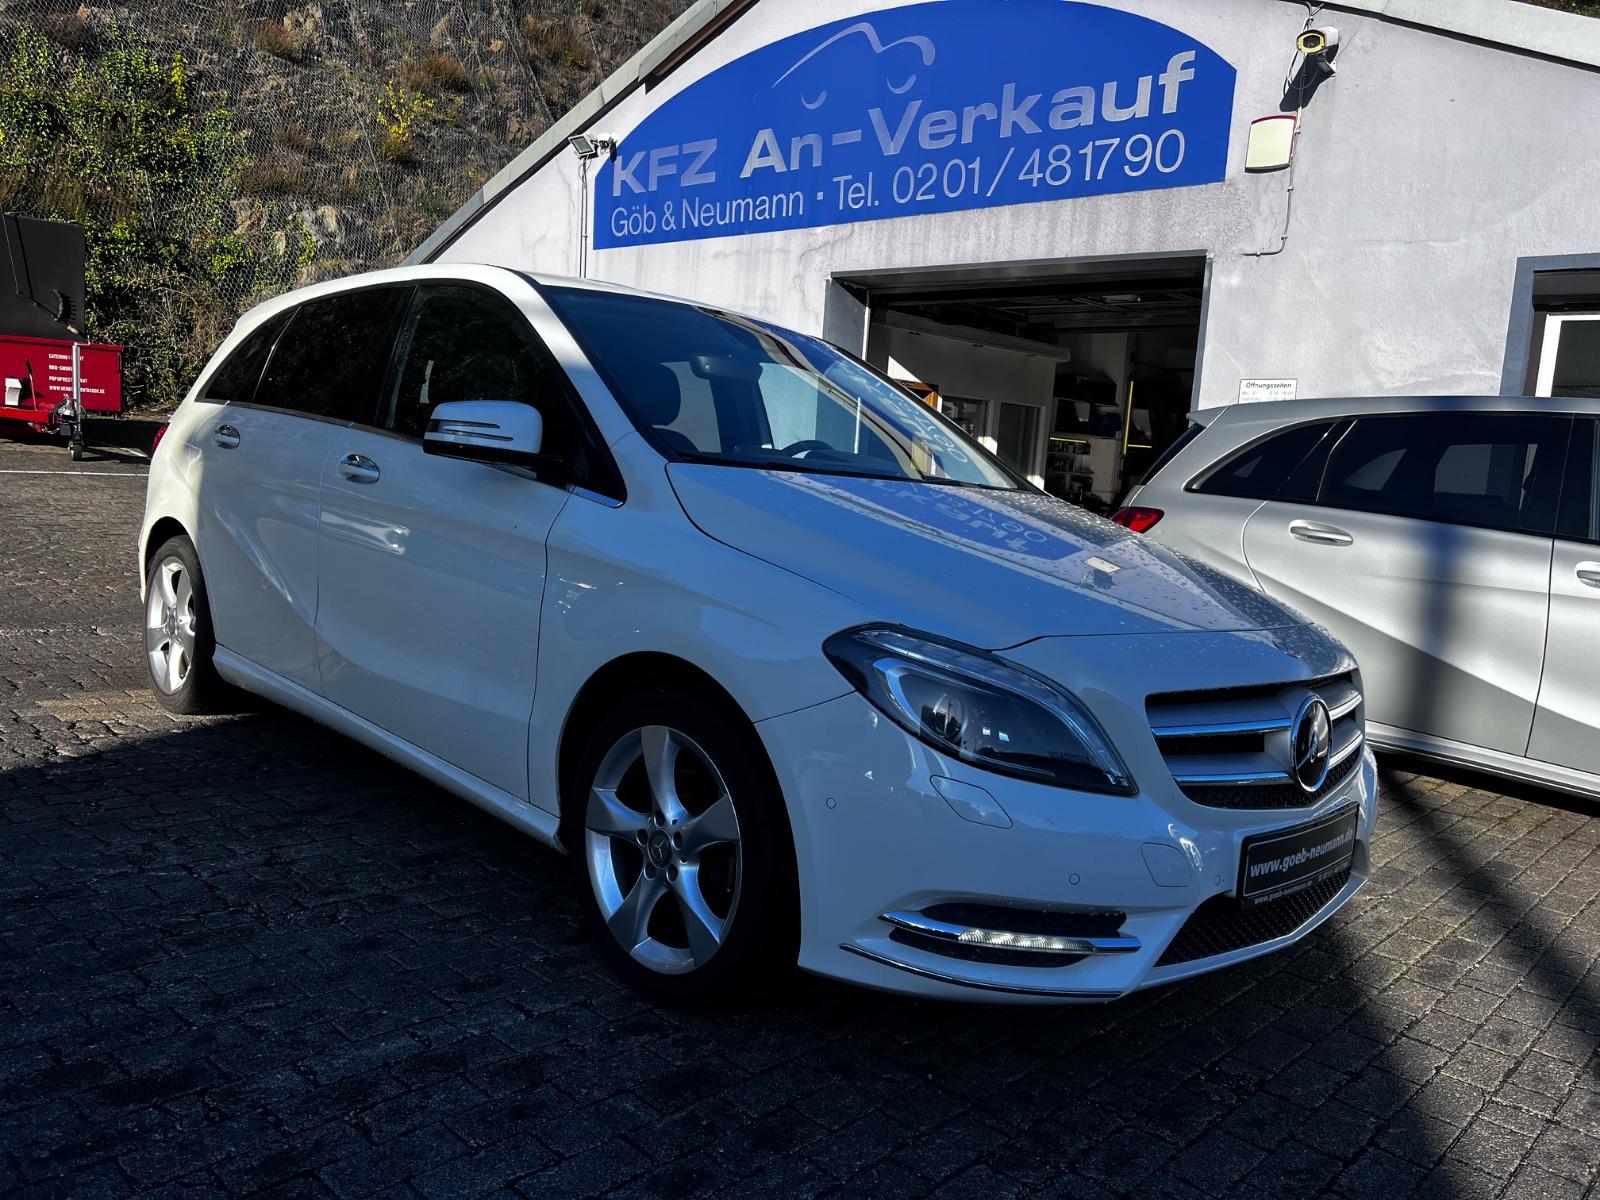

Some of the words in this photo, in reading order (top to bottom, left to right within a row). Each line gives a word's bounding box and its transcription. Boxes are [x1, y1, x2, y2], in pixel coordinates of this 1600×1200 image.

[611, 137, 718, 197] KFZ
[611, 202, 656, 237] Göb
[661, 201, 677, 231] &
[682, 190, 804, 230] Neumann
[832, 172, 880, 211] Tel.
[1246, 382, 1292, 390] Öffnungszeiten
[1250, 827, 1352, 878] www.goeb-neumann.de
